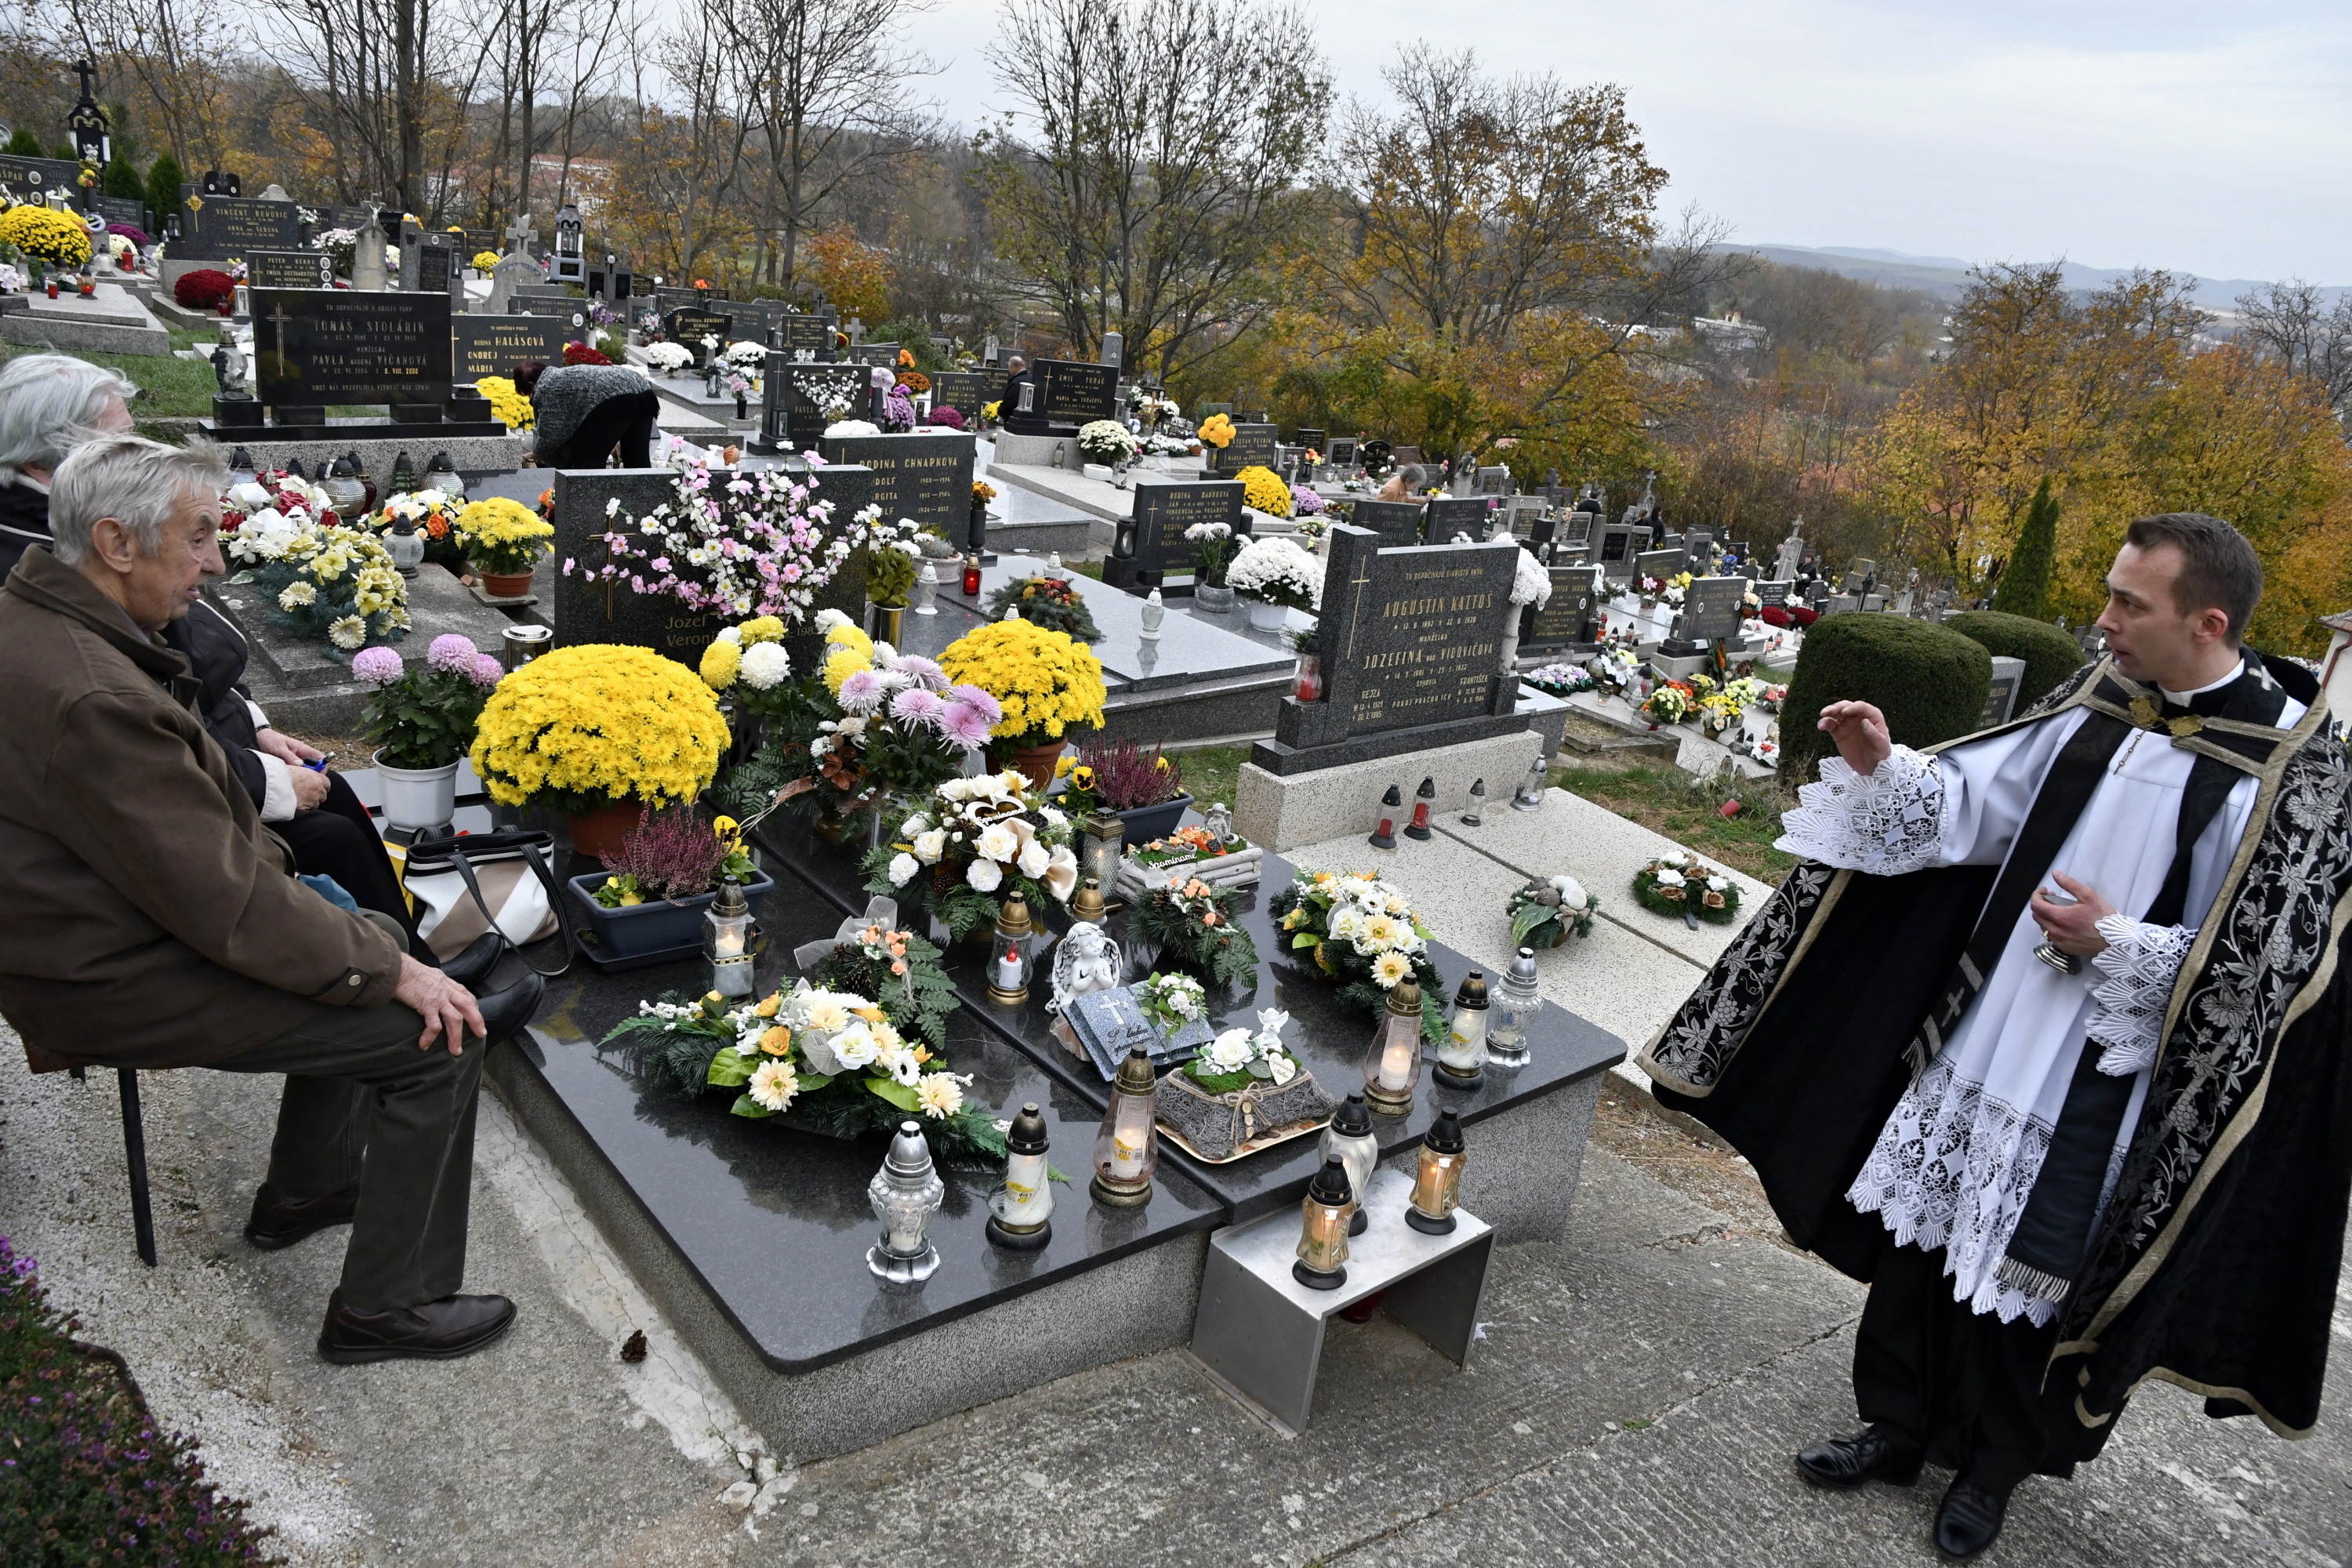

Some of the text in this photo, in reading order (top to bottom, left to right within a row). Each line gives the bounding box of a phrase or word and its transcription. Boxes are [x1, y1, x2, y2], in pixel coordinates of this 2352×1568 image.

[0, 169, 23, 181] ŠPAR
[216, 208, 248, 216] VINCENT
[314, 318, 424, 333] TOMÁŠ STOLÁRIK
[313, 355, 344, 365] PAVLA
[467, 351, 498, 360] ONDREJ
[468, 362, 493, 373] MÁRIA
[875, 477, 896, 485] DOLF
[873, 492, 898, 501] RGITA
[1378, 530, 1406, 541] IDOVIČ
[665, 613, 708, 630] Jozef
[666, 633, 716, 647] Veroni
[1459, 673, 1489, 686] FRANTIŠEK
[1108, 1029, 1120, 1044] S
